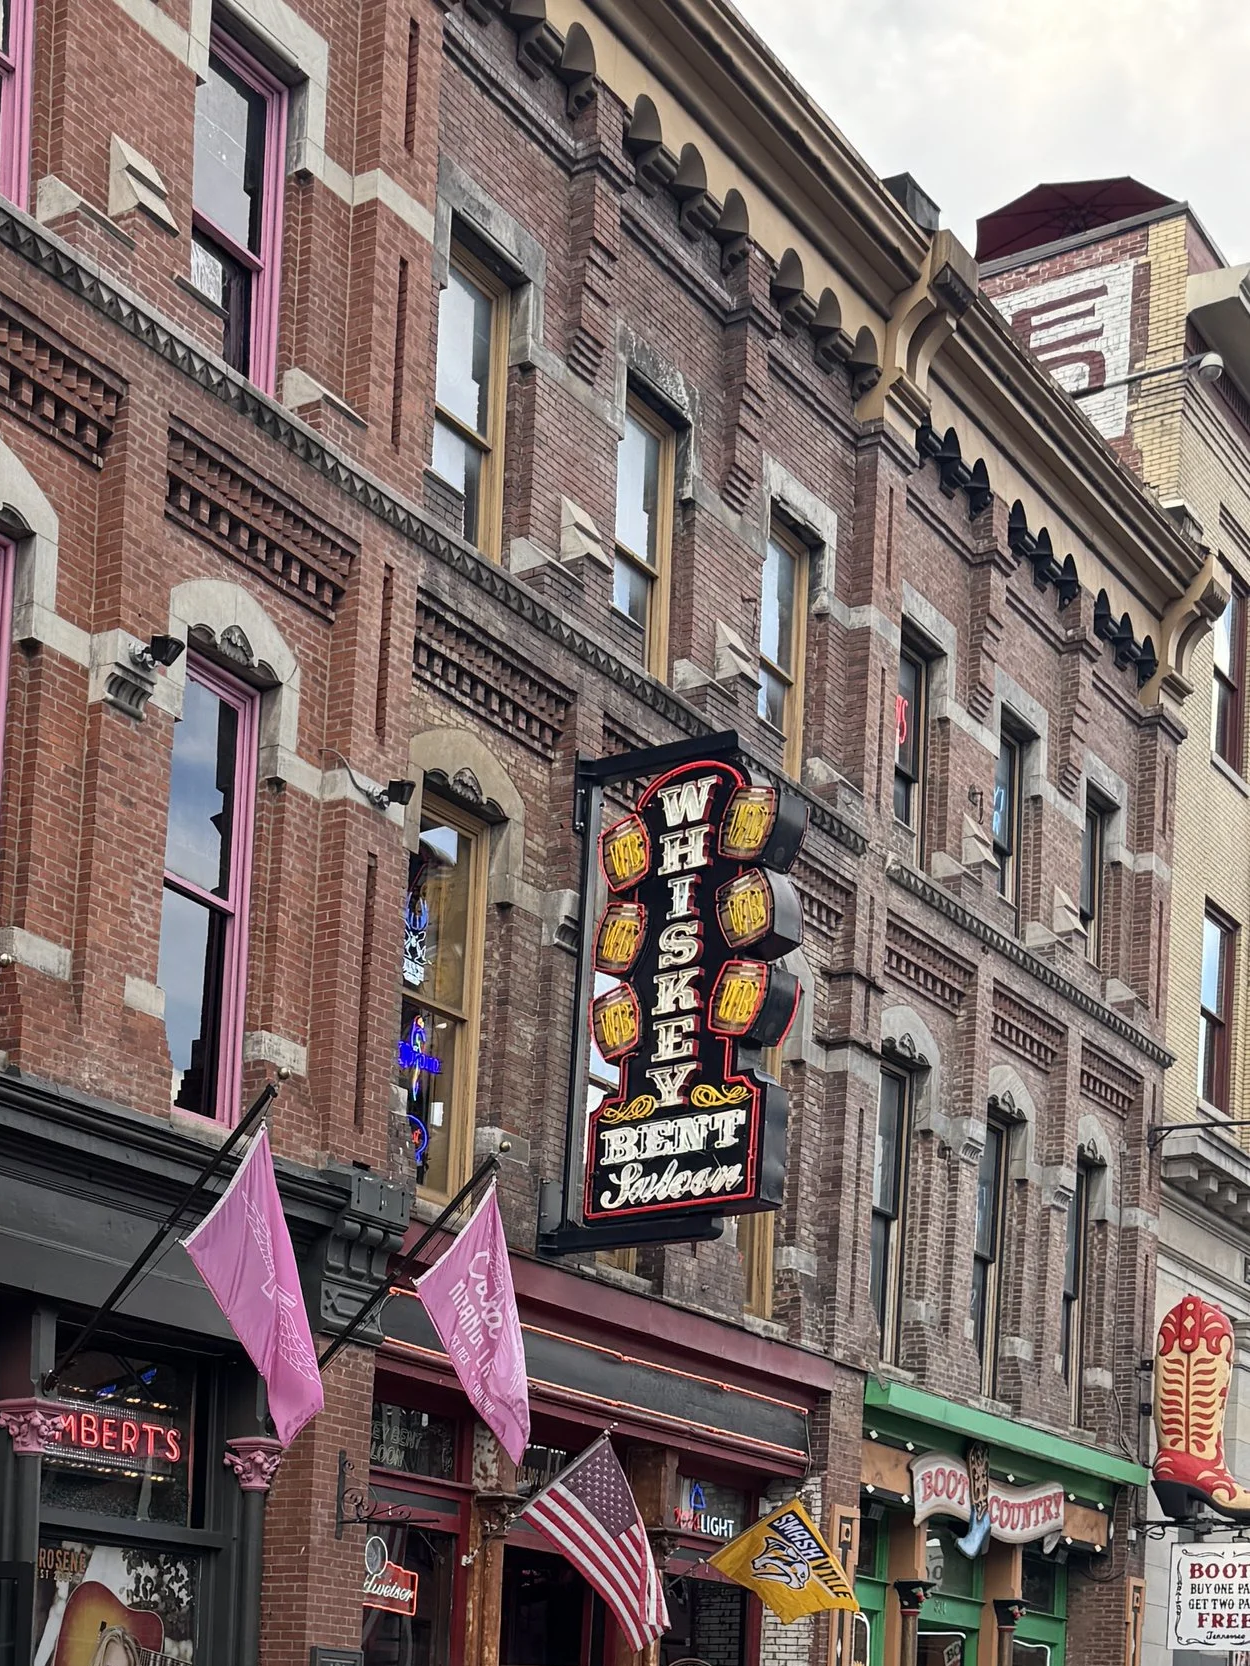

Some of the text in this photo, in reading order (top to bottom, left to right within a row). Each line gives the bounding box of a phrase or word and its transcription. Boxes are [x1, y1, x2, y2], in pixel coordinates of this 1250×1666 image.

[646, 775, 720, 1107] WHISKEY
[600, 1109, 745, 1166] BENT
[921, 1467, 969, 1506] BOOT
[701, 1513, 735, 1538] LIGHT
[988, 1491, 1065, 1531] COUNTRY
[1188, 1599, 1209, 1610] GET
[1211, 1599, 1235, 1610] TWO
[1190, 1583, 1212, 1595] BUY
[1214, 1583, 1234, 1595] ONE
